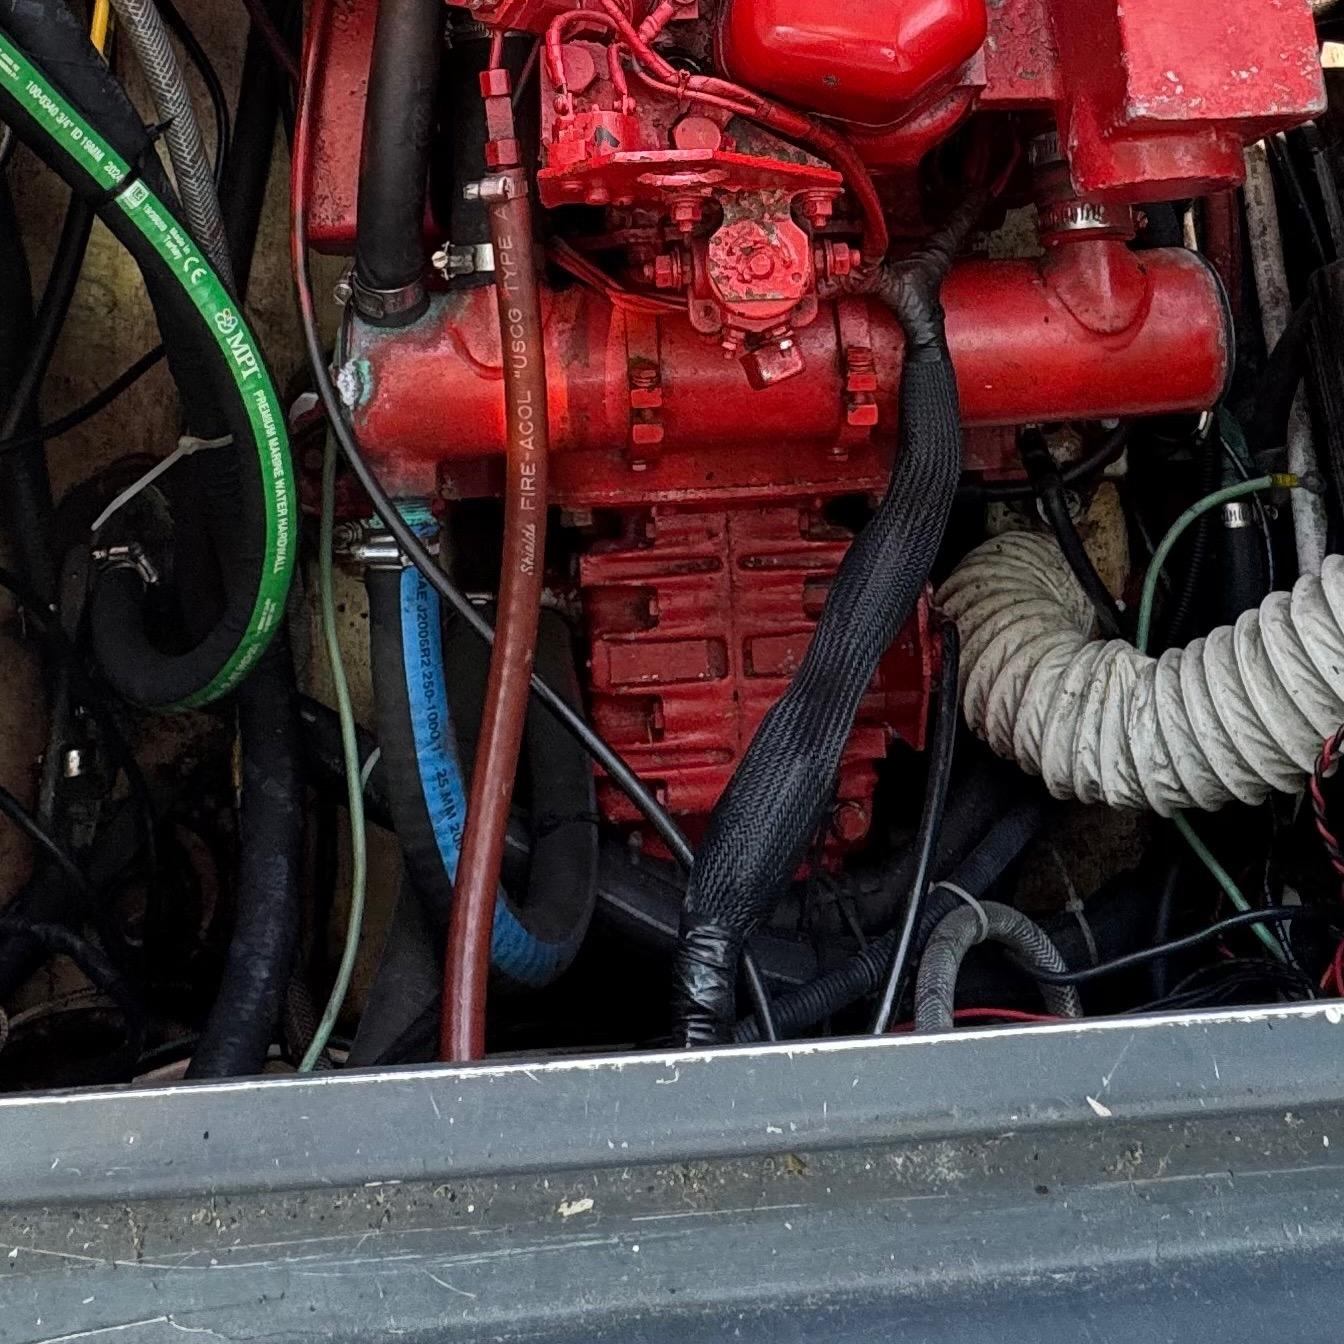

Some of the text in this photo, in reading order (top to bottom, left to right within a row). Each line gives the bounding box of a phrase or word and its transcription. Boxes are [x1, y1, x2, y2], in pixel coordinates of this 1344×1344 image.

[68, 126, 84, 141] ID
[77, 135, 106, 162] 19MM
[101, 160, 125, 183] 2024
[496, 207, 513, 223] A
[159, 233, 184, 261] Turkey
[181, 243, 193, 255] in
[501, 236, 526, 297] TYPE
[223, 327, 289, 574] MPI PREMIUM MARINE WATER HARDWALL
[515, 390, 539, 512] FIRE-ACOL
[517, 523, 537, 576] Shields
[414, 603, 432, 668] J2006R2
[421, 670, 440, 741] 250-1000
[434, 767, 450, 788] 25
[438, 790, 457, 821] MM
